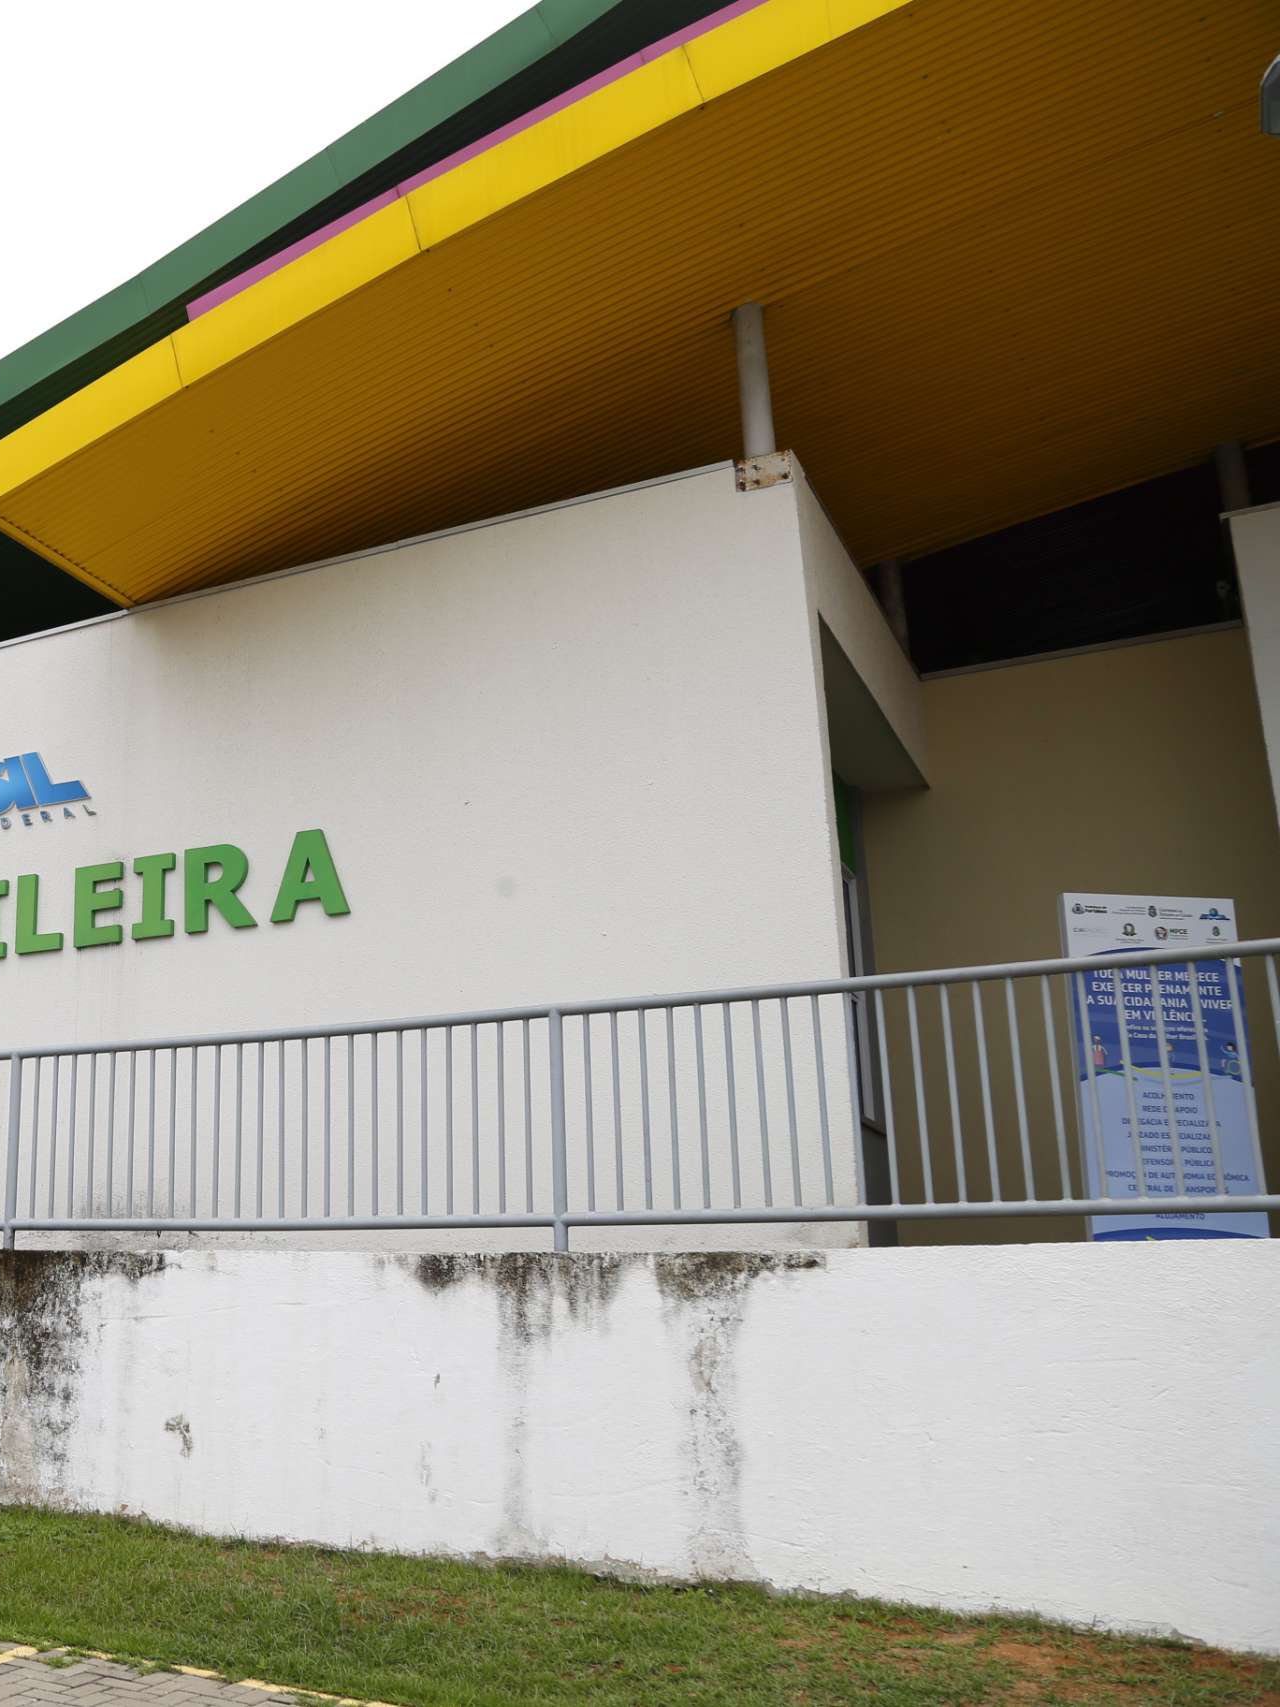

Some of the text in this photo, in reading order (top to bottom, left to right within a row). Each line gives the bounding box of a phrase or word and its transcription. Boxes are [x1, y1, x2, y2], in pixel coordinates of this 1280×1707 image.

[1126, 970, 1172, 980] MULER
[1175, 972, 1219, 982] MEECE
[1092, 981, 1142, 992] EXECER
[1124, 996, 1187, 1008] CIDAANIA
